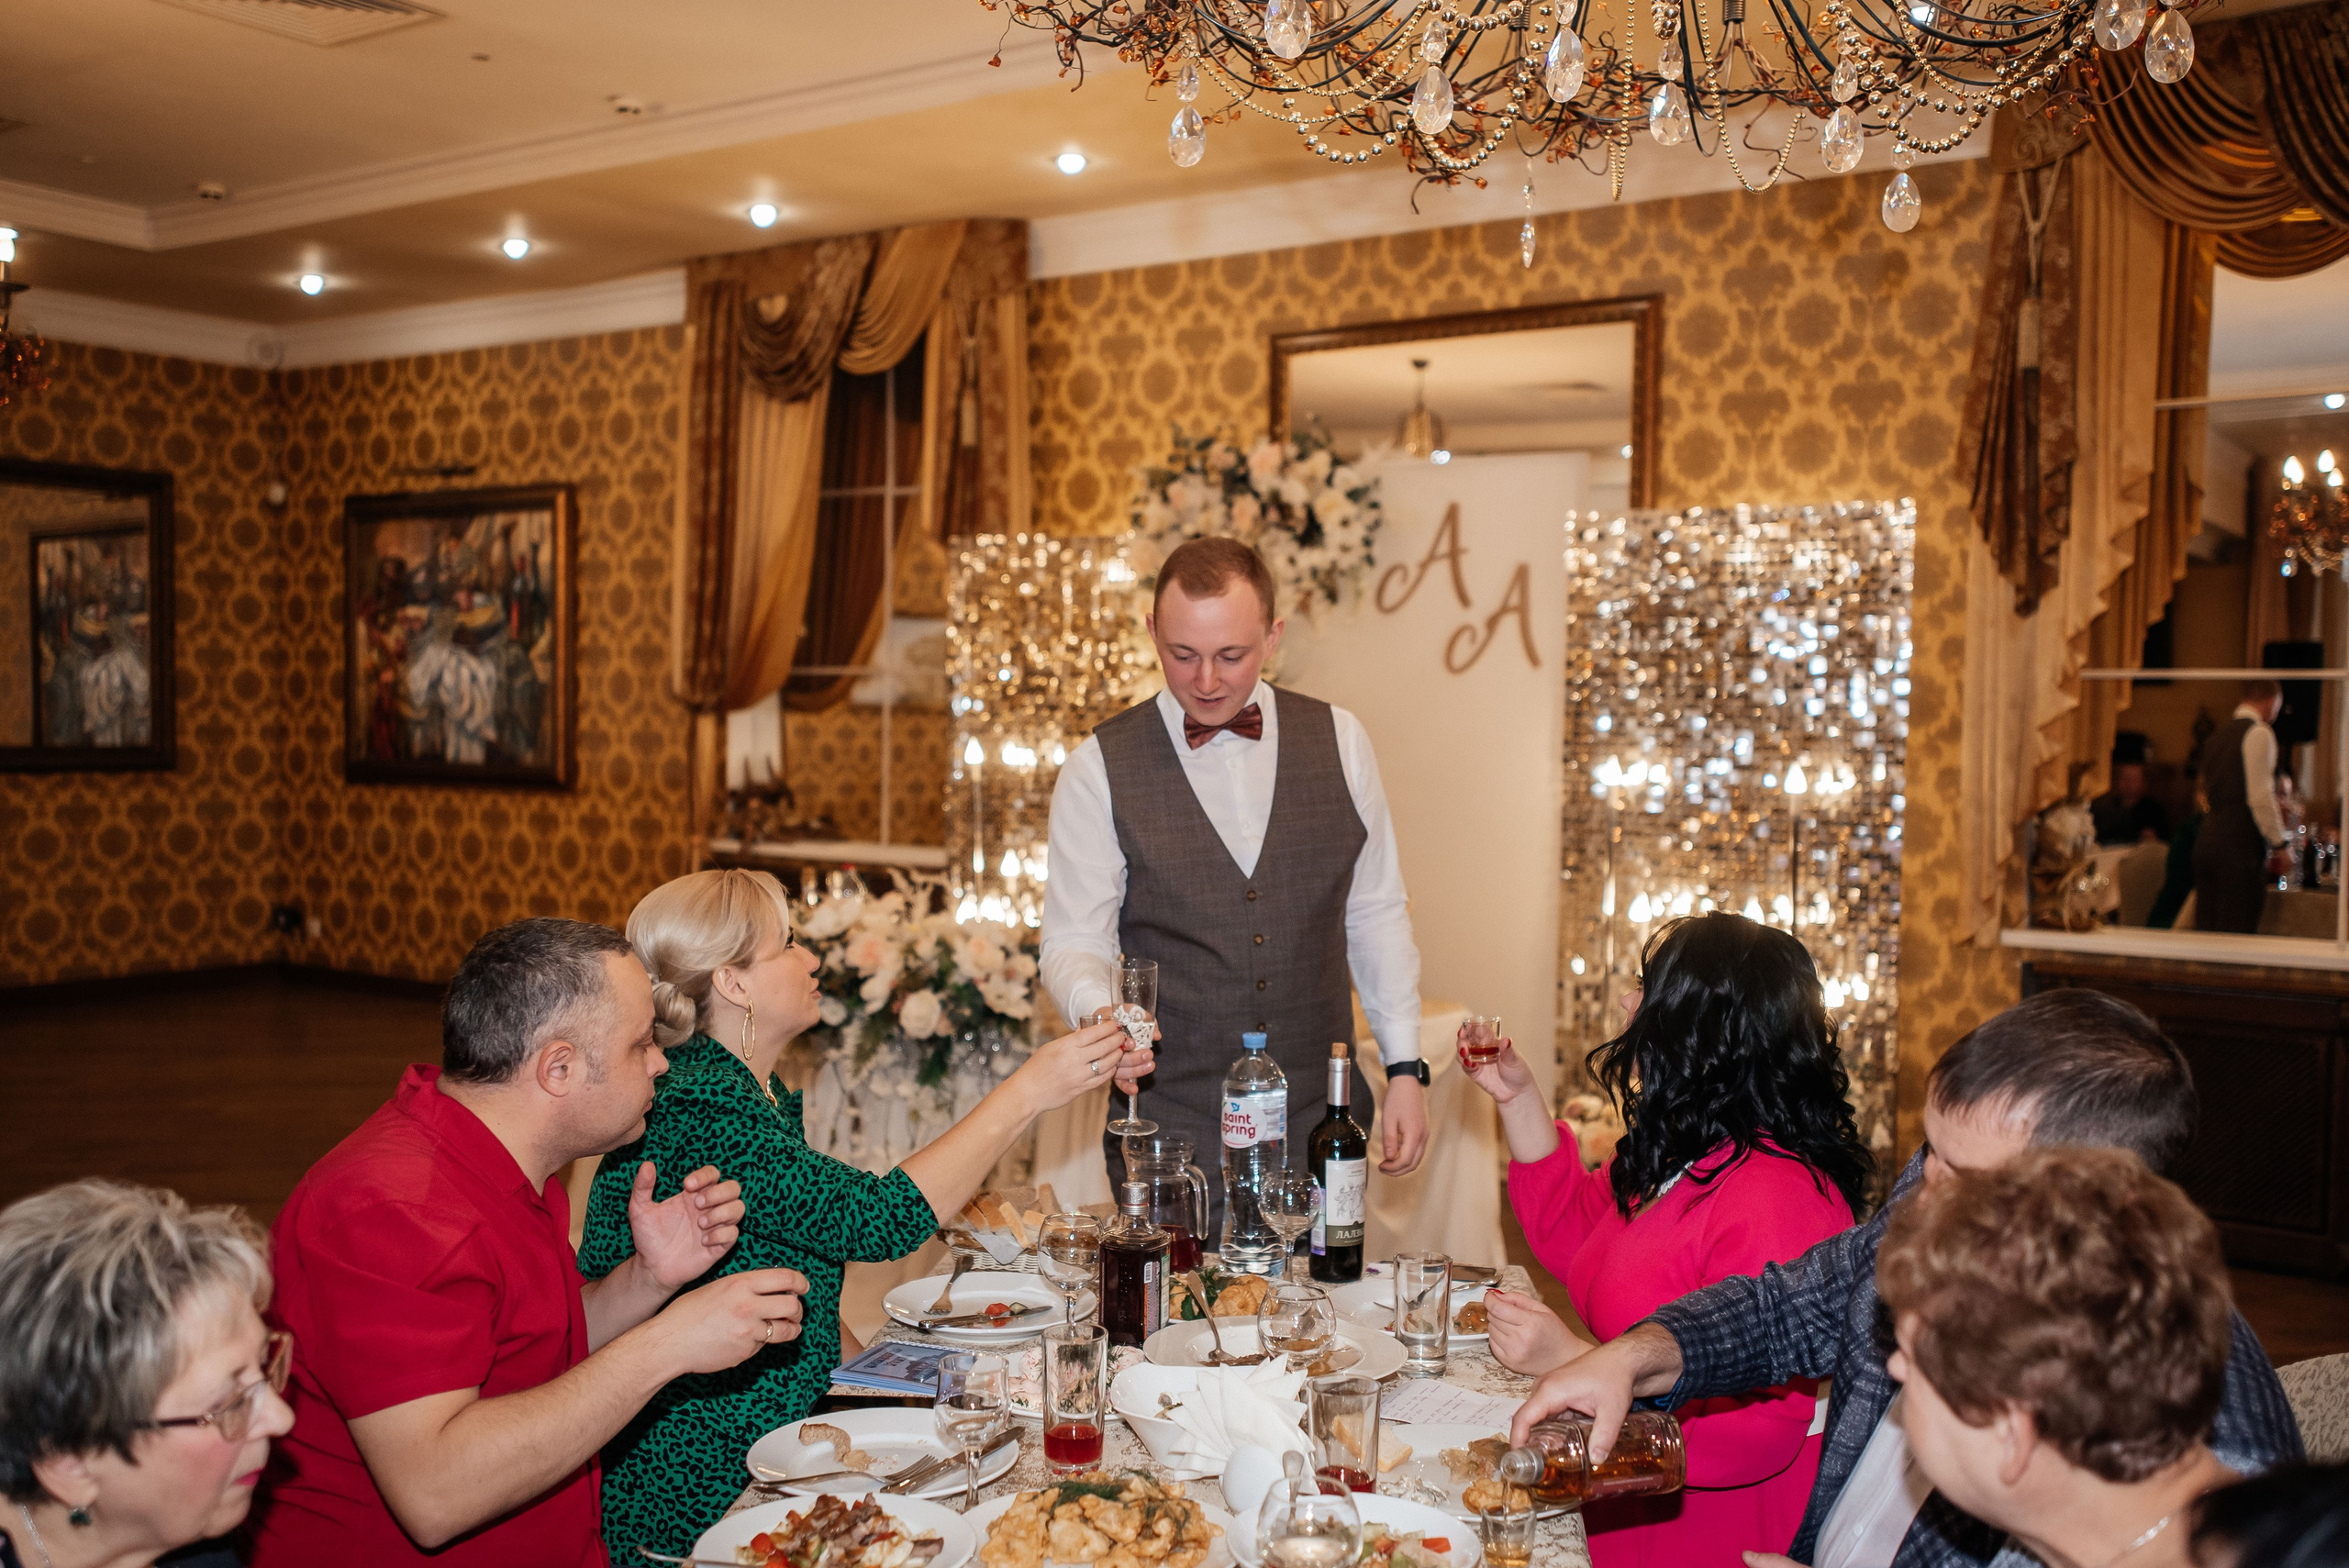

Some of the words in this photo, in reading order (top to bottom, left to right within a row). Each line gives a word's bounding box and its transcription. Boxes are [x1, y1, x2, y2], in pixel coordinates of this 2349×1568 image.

[1375, 502, 1471, 614] A
[1444, 563, 1541, 673] A
[1222, 1122, 1256, 1139] spring
[1224, 1113, 1252, 1125] saint
